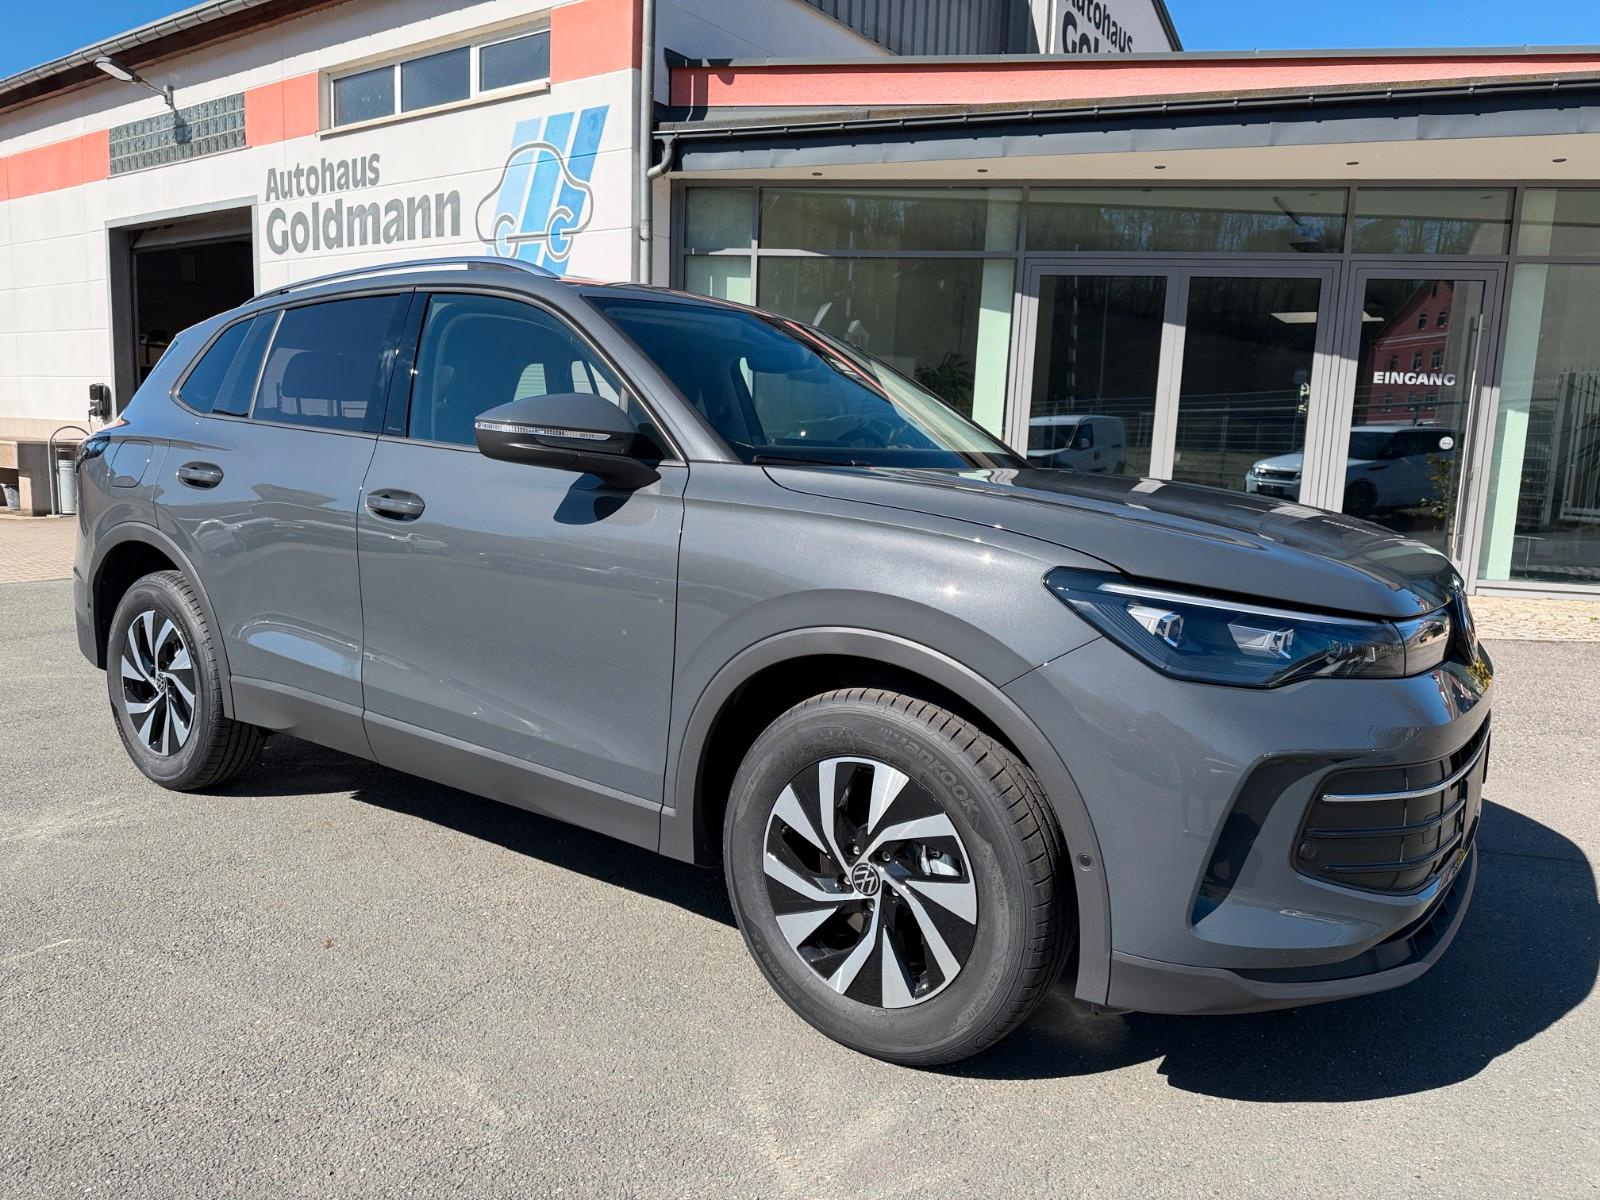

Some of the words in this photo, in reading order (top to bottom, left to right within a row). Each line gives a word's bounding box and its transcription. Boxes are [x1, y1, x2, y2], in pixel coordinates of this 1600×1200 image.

[265, 153, 381, 202] Autohaus
[266, 190, 461, 255] Goldmann
[1373, 371, 1456, 386] EINGANG
